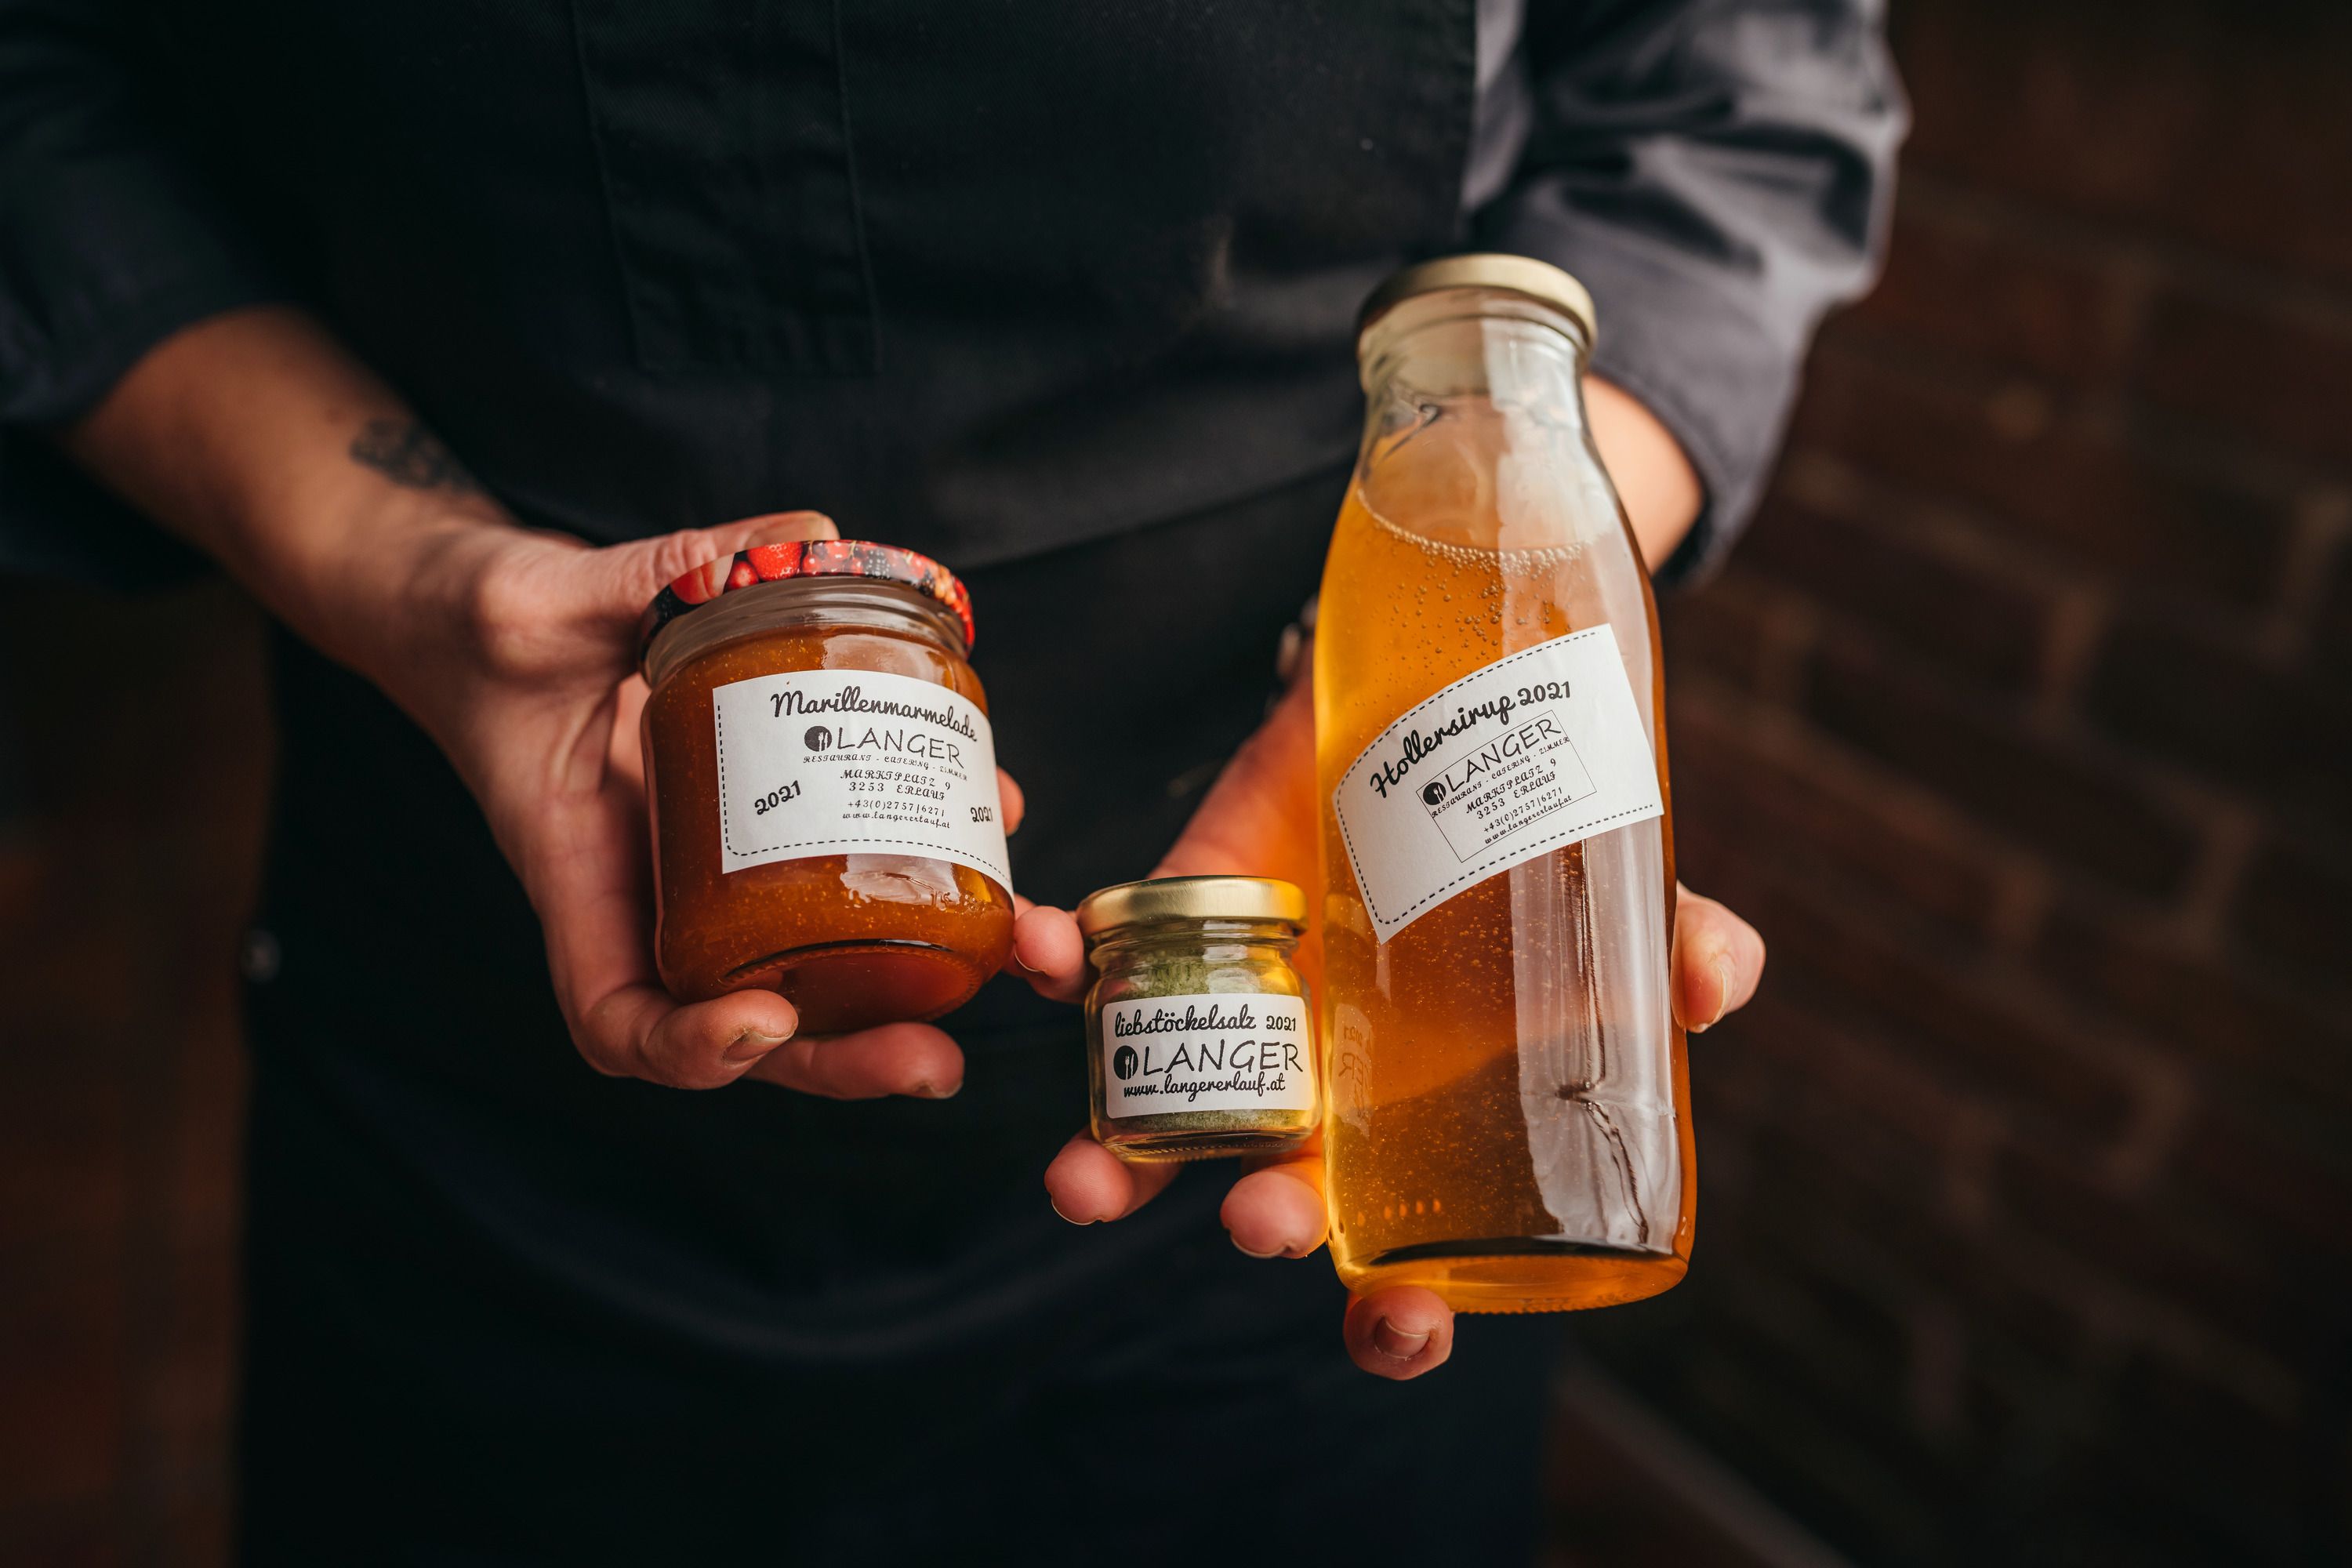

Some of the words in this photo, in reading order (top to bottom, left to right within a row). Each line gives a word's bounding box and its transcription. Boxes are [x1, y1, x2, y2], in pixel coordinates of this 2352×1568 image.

[771, 685, 978, 742] Marillenmarmelade
[837, 727, 965, 769] LANGER
[1370, 695, 1516, 799] Hollersirup
[1517, 681, 1571, 706] 2021
[1445, 719, 1562, 793] LANGER
[803, 753, 872, 764] RESTAURANT
[840, 769, 936, 787] MARKTPLATZ
[945, 781, 951, 790] 9
[848, 781, 884, 792] 3253
[1432, 781, 1483, 818] RESTAURANT
[1491, 754, 1531, 779] CATERING
[1466, 765, 1544, 814] MARKTPLATZ
[1550, 758, 1556, 767] 9
[1476, 797, 1505, 819] 3253
[1513, 771, 1556, 799] ERLAUF
[753, 780, 801, 815] 2021
[970, 806, 994, 823] 2021
[1266, 1014, 1296, 1033] 2021
[1142, 1039, 1304, 1073] LANGER
[1123, 1071, 1286, 1102] www.langererlauf.at
